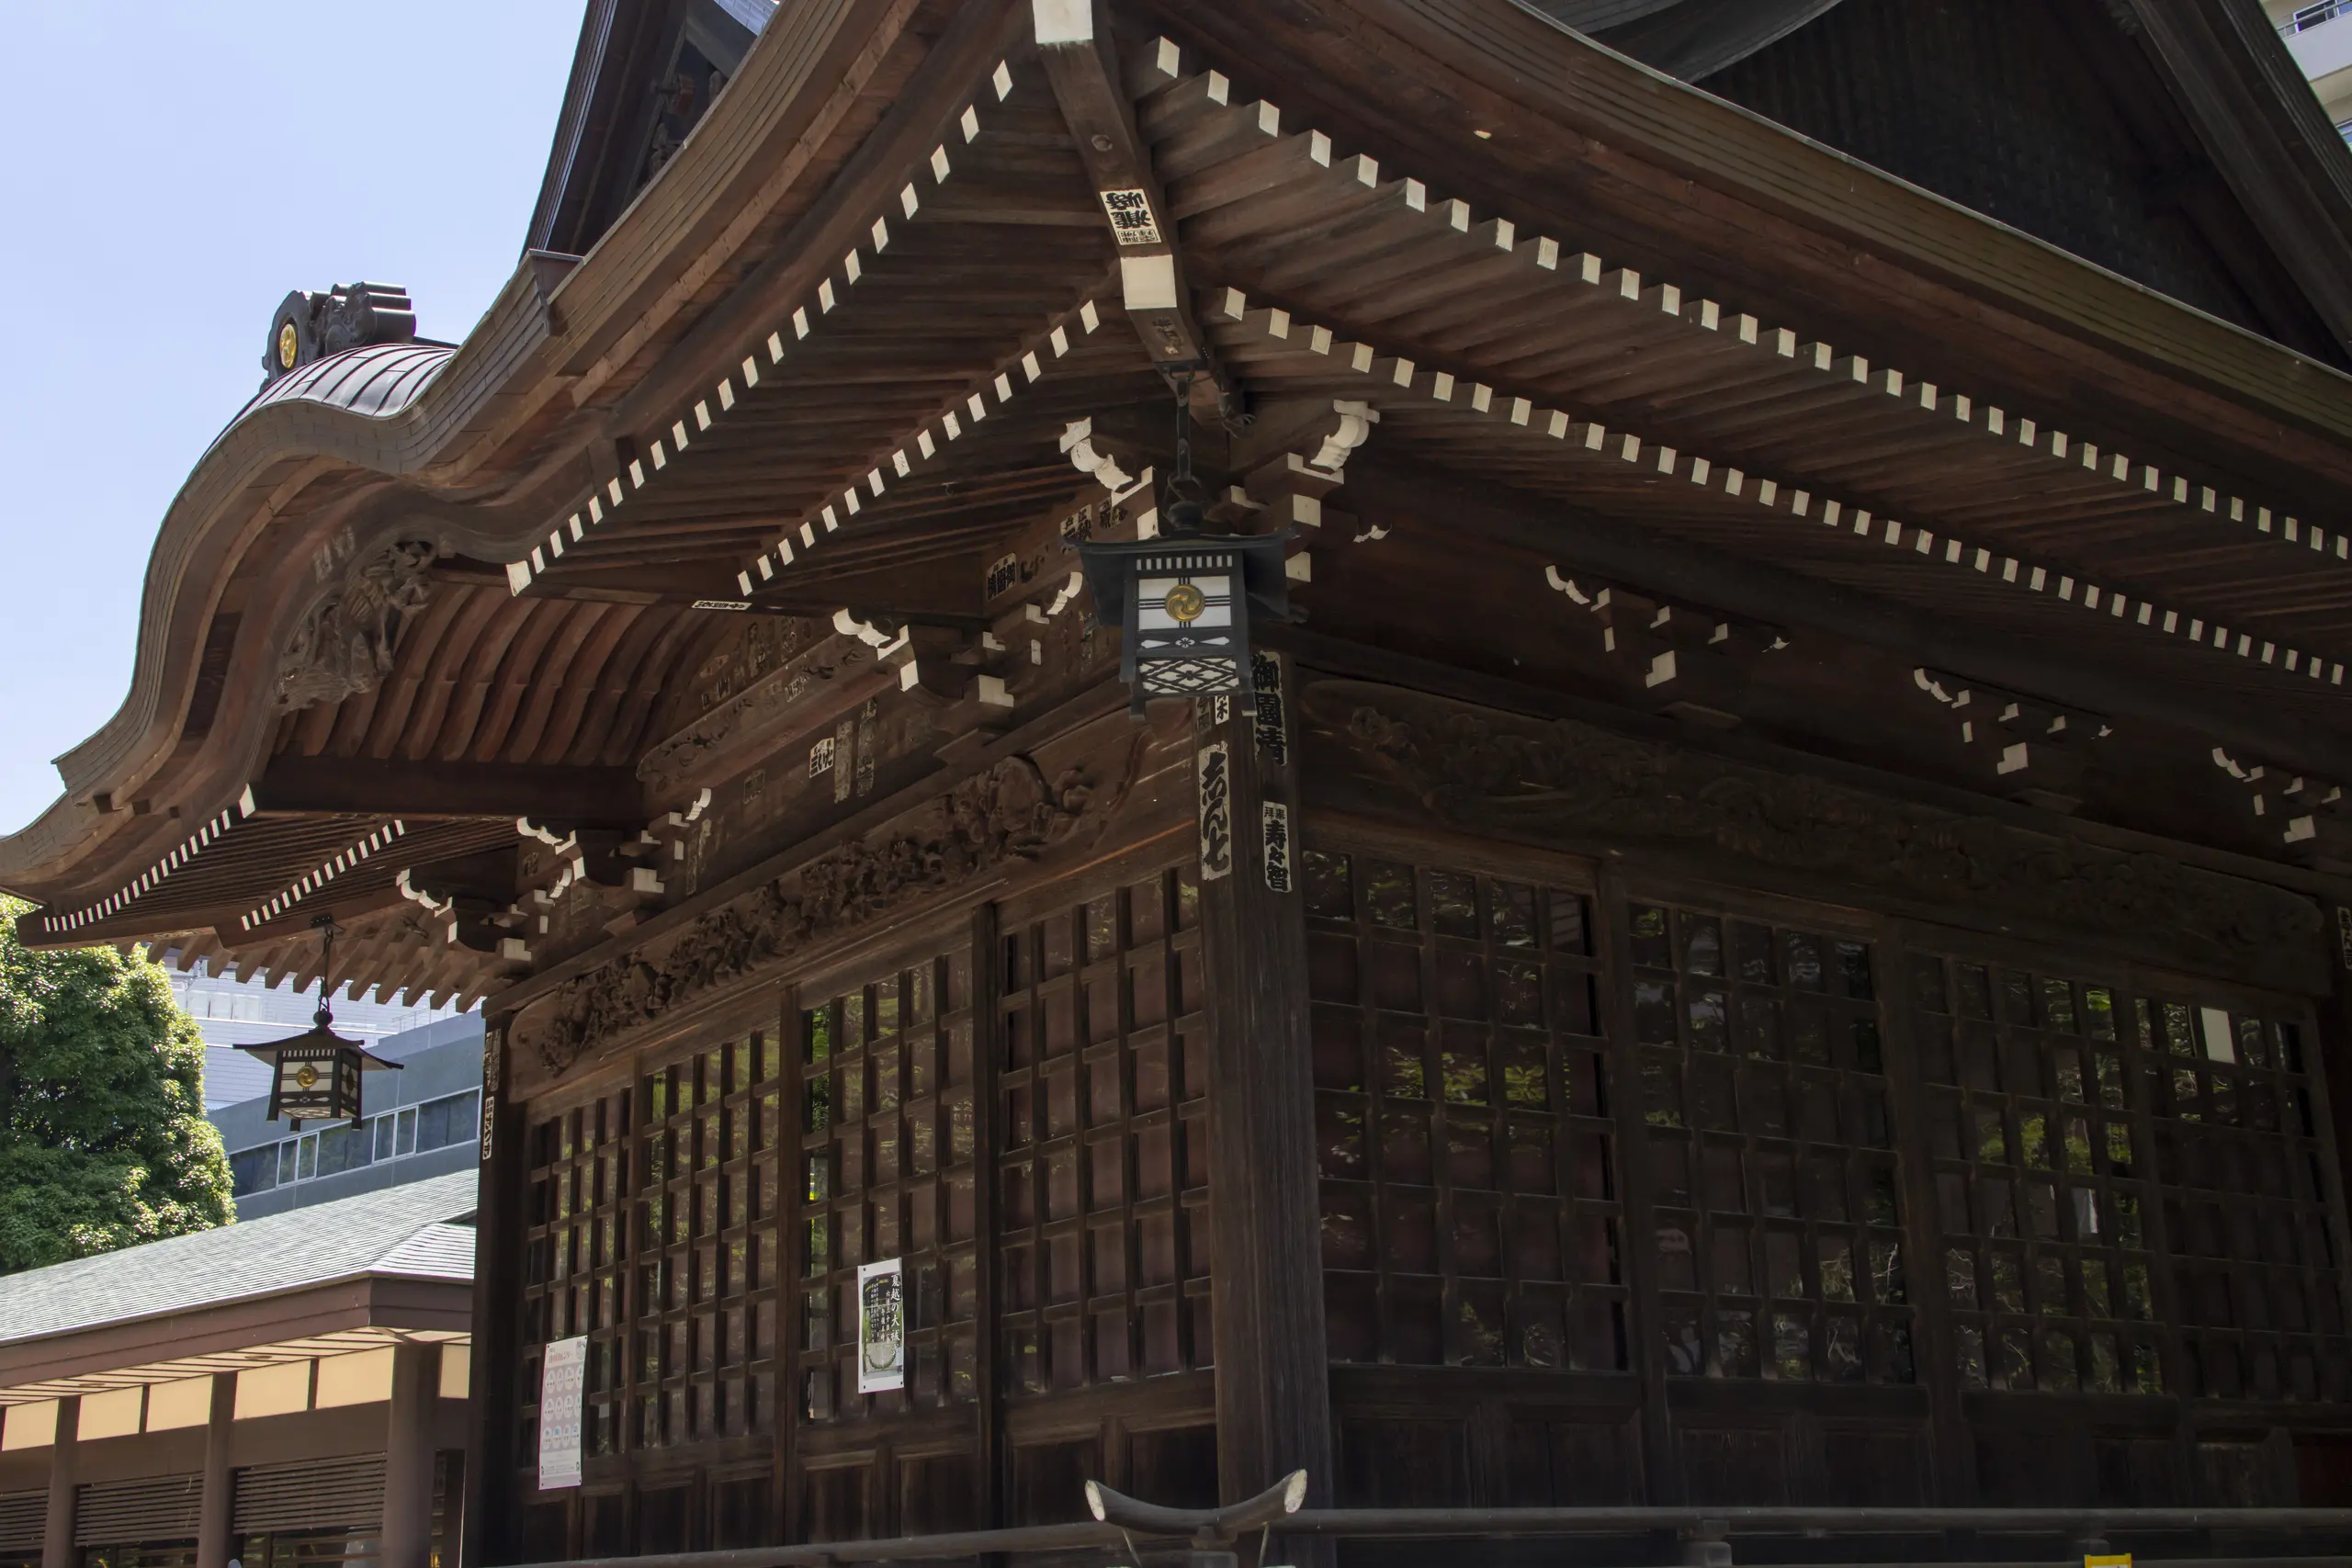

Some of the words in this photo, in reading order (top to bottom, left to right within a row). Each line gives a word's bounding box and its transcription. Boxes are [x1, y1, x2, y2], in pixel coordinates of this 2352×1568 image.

[1251, 654, 1287, 765] 御園清
[890, 1274, 900, 1357] 夏越の大祓式
